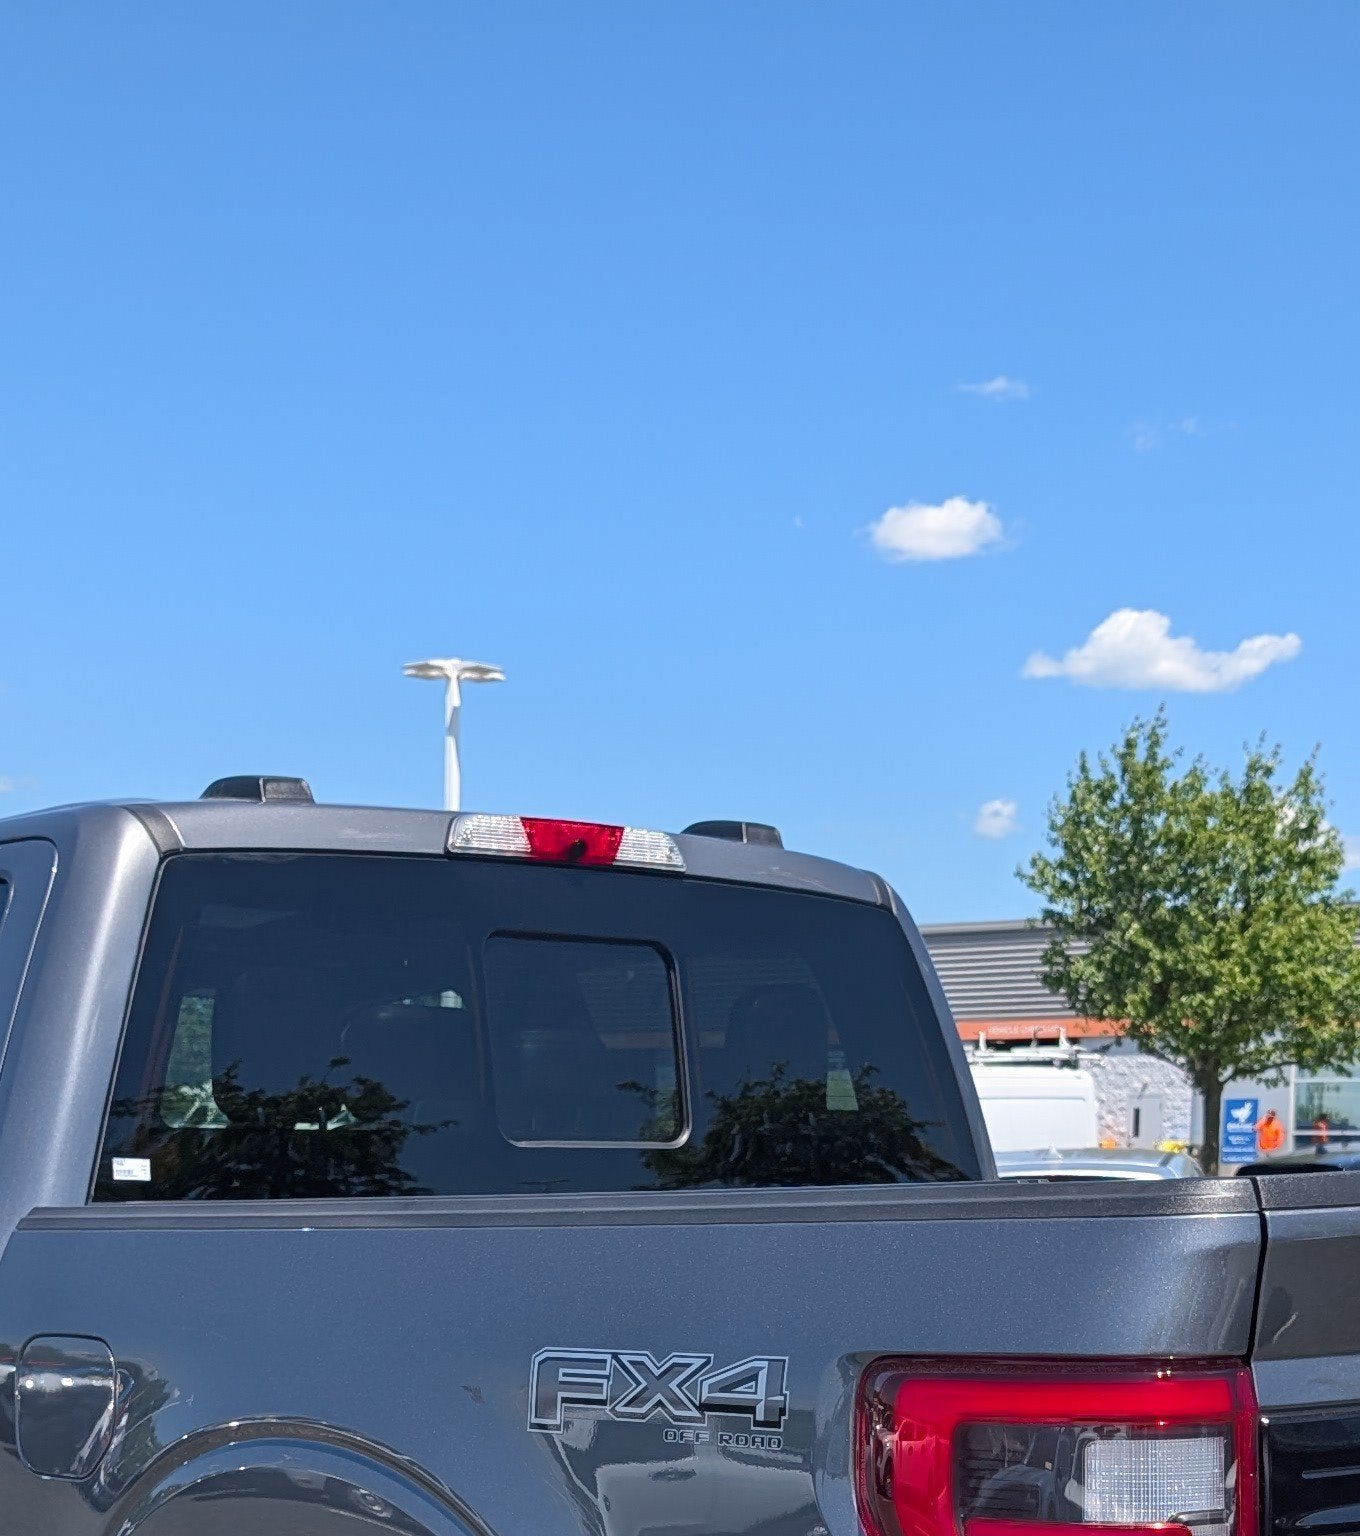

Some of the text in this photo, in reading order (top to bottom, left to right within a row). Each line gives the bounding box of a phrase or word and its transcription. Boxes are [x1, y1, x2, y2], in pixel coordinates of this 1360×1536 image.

[527, 1346, 789, 1434] FX4
[663, 1428, 783, 1449] OFF ROAD
